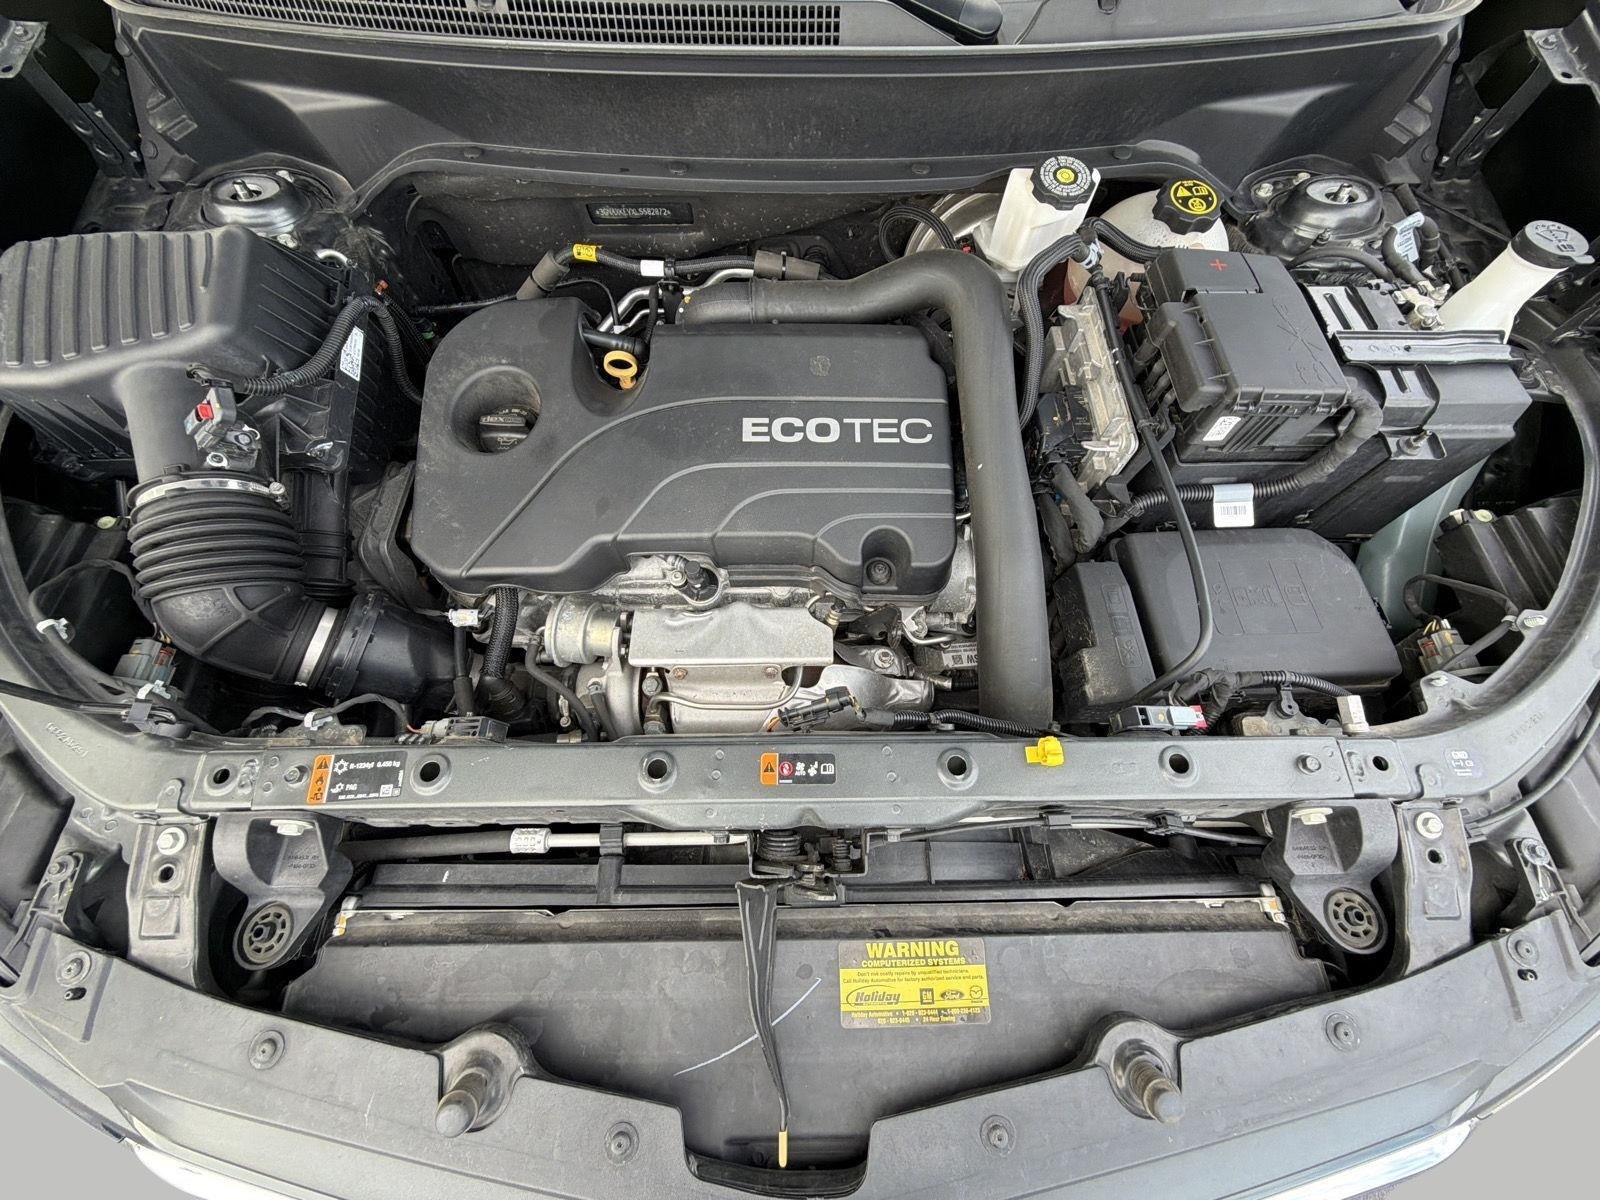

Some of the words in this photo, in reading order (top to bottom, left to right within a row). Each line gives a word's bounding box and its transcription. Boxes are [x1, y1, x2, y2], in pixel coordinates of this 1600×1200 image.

[742, 417, 933, 444] ECOTEC
[866, 940, 959, 958] WARNING
[861, 959, 926, 968] COMPUTERIZED
[927, 957, 966, 966] SYSTEMS
[855, 990, 900, 1005] Holiday
